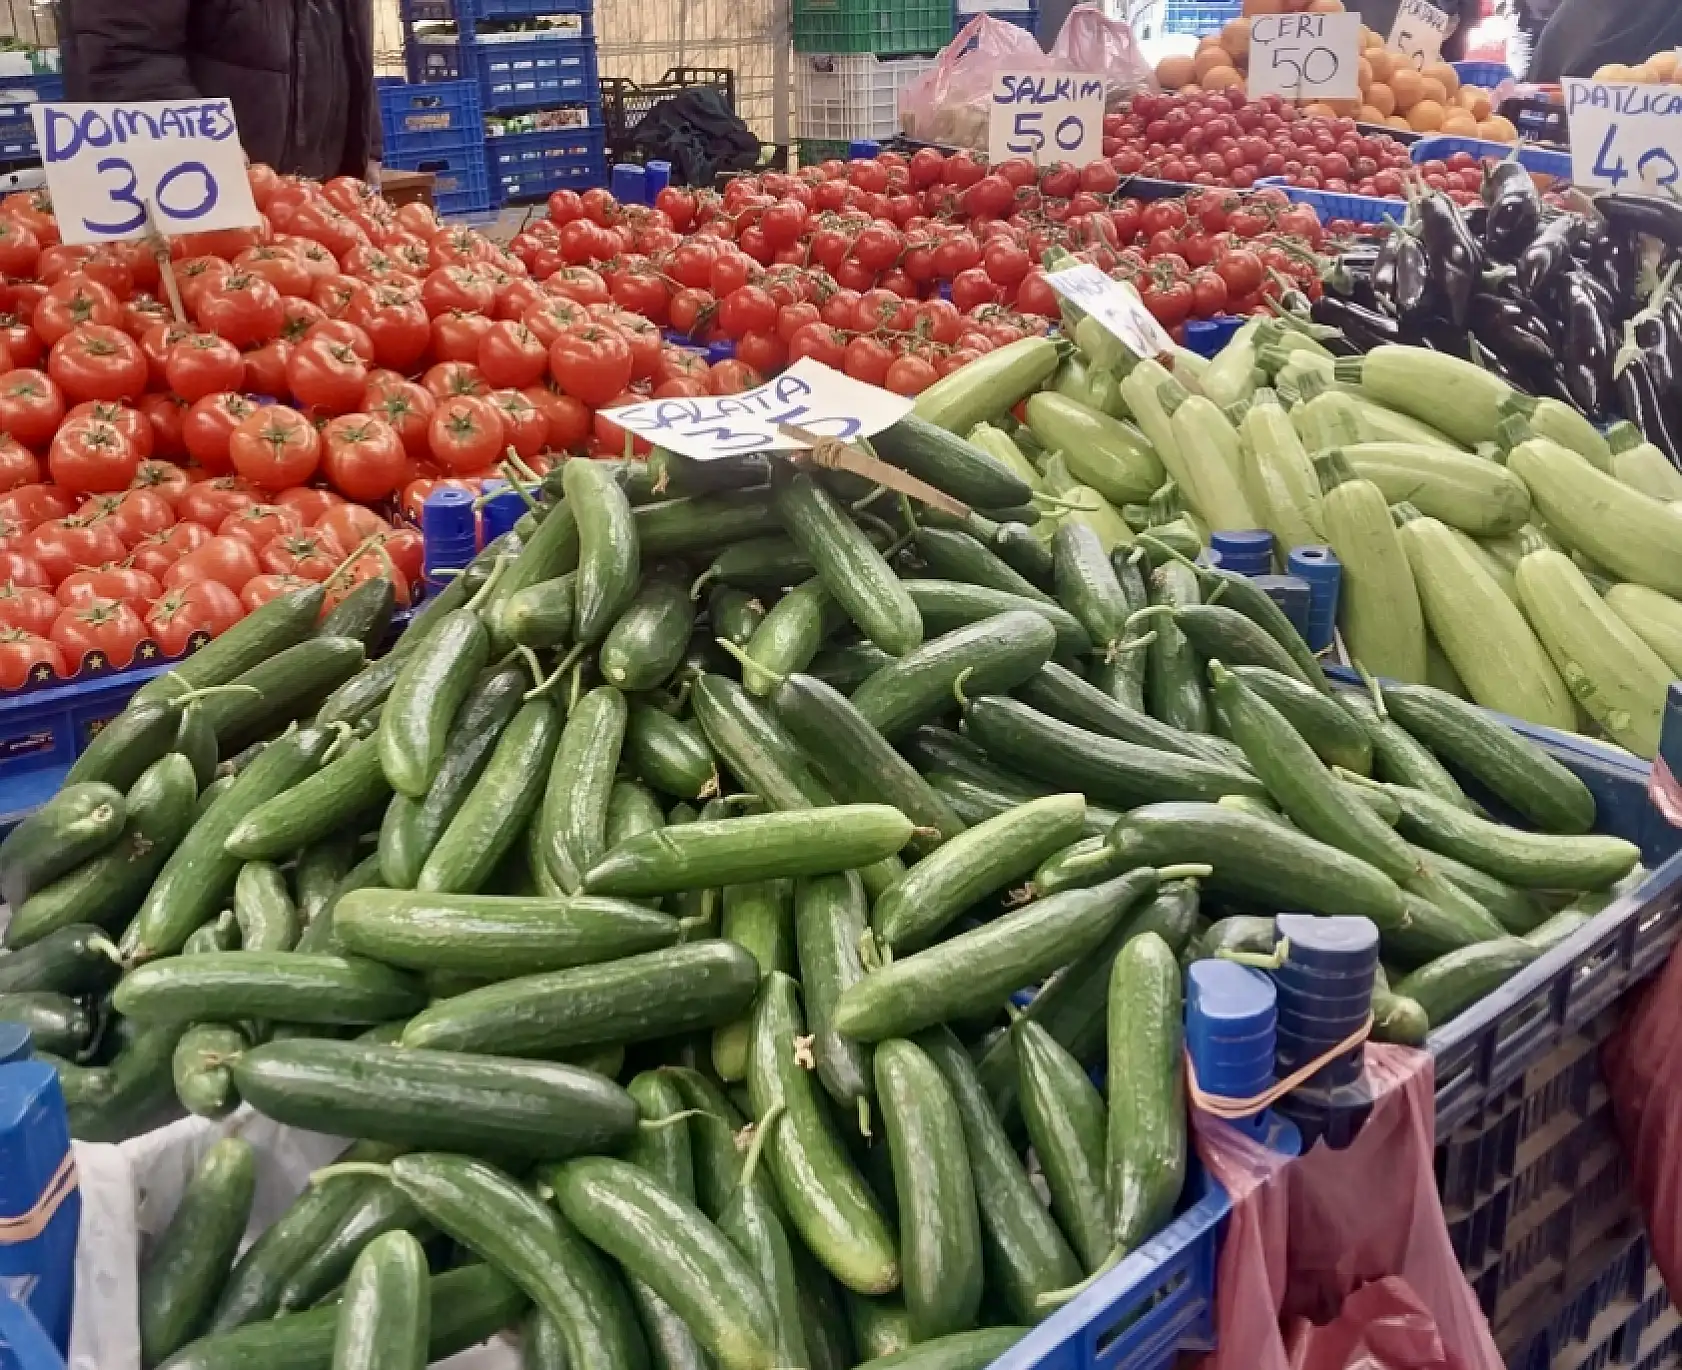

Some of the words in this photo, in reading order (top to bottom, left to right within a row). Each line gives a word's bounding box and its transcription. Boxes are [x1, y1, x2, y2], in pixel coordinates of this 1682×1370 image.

[1271, 46, 1339, 88] 50
[44, 101, 236, 163] DOMATES
[1006, 112, 1084, 153] 50
[1592, 123, 1679, 188] 40
[82, 157, 219, 234] 30
[618, 374, 812, 430] SALATA
